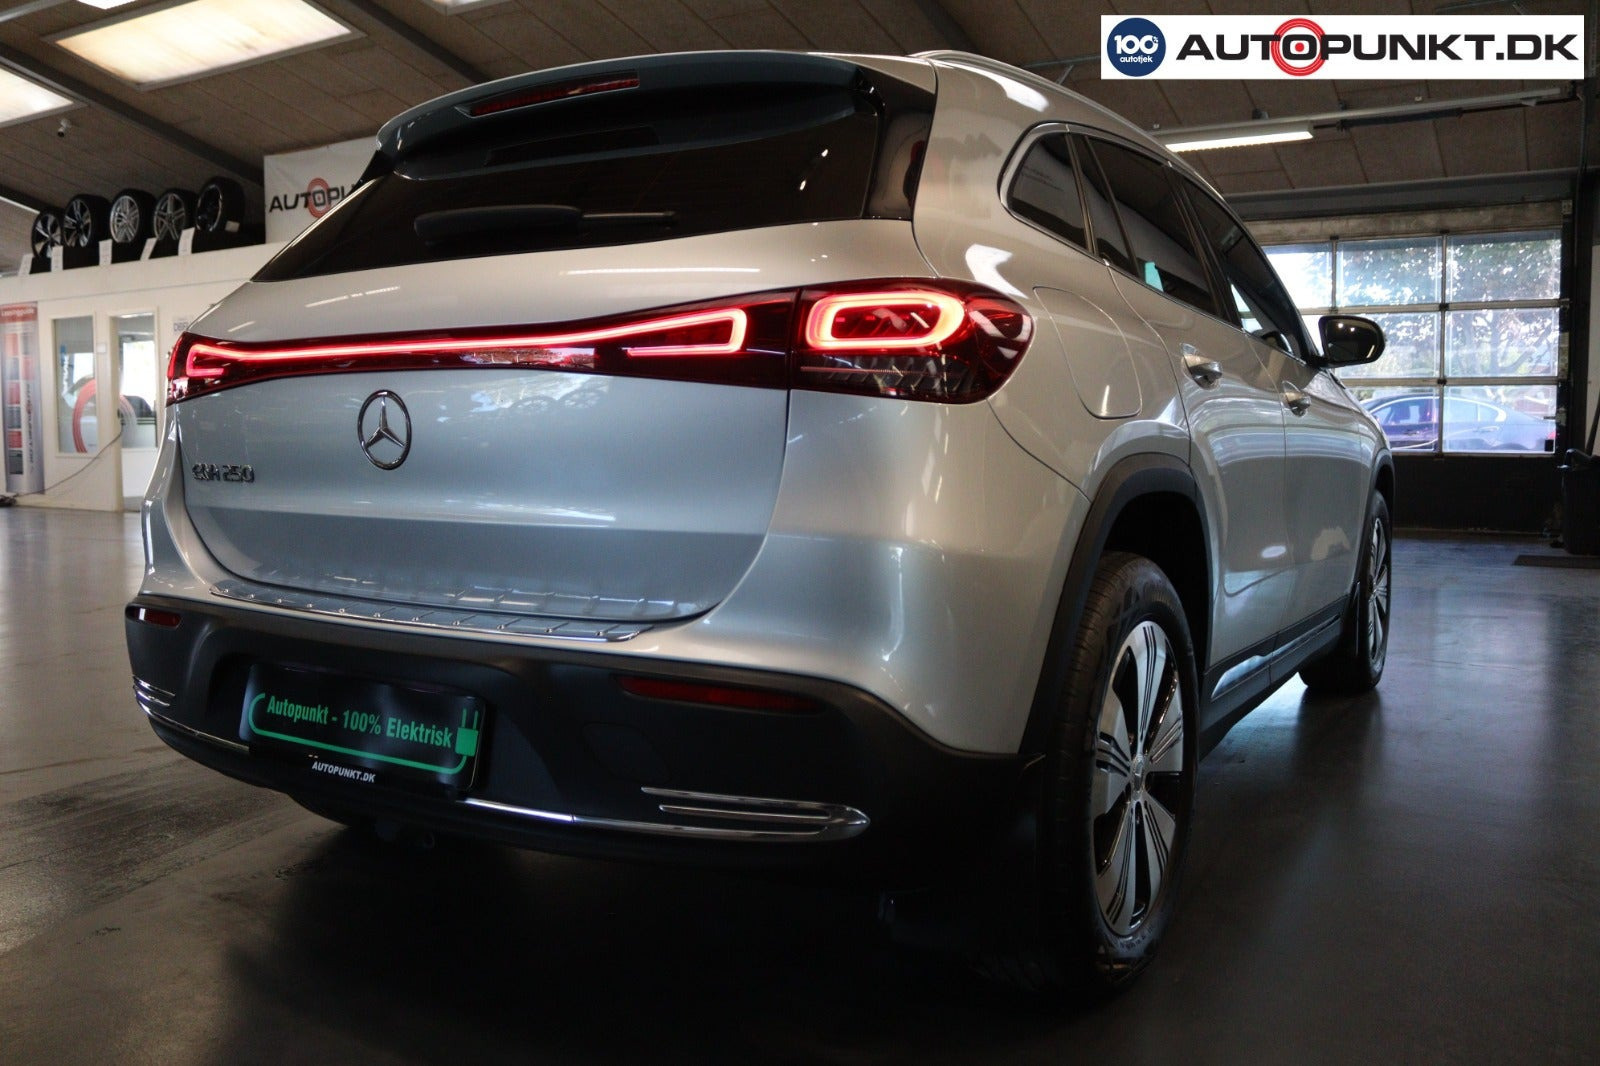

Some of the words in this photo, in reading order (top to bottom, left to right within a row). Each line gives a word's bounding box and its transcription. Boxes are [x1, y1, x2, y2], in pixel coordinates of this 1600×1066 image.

[222, 464, 255, 482] 250
[267, 695, 328, 725] Autopunkt
[343, 709, 381, 735] 100%
[386, 717, 452, 748] Elektrisk
[311, 761, 376, 783] AUTOPUNKT.DK
